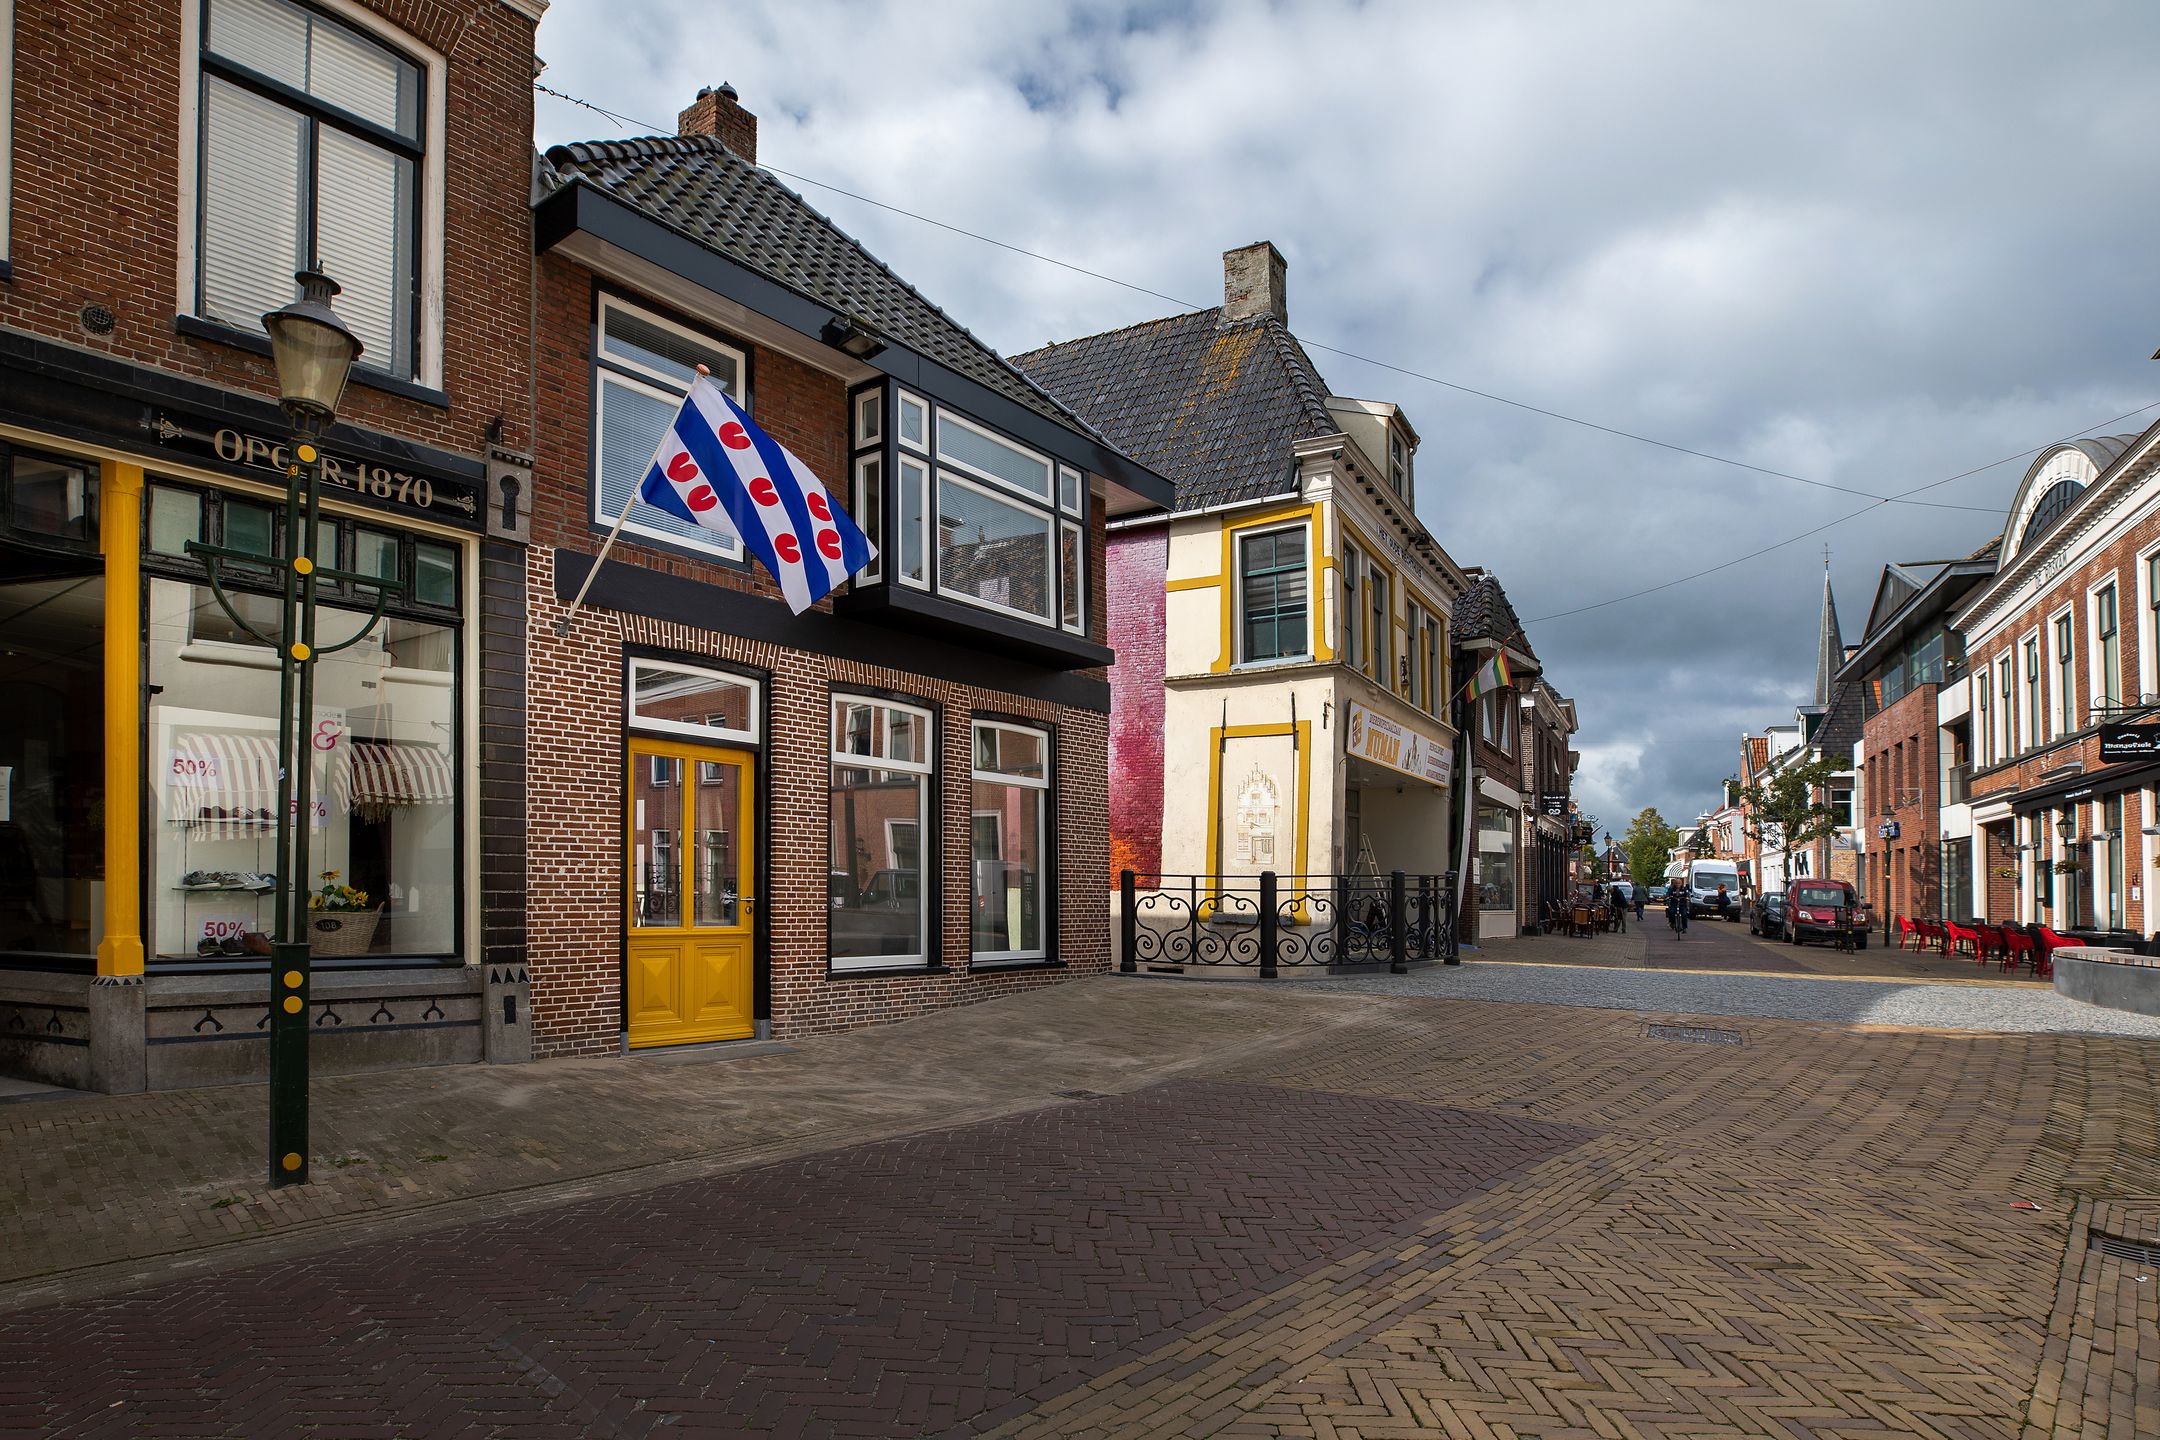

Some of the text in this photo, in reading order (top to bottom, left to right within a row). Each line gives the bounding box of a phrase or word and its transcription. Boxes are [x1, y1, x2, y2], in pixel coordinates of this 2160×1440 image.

[356, 463, 433, 508] 1870
[1365, 727, 1400, 767] NUMAN
[173, 758, 217, 777] 50%
[204, 921, 247, 939] 50%
